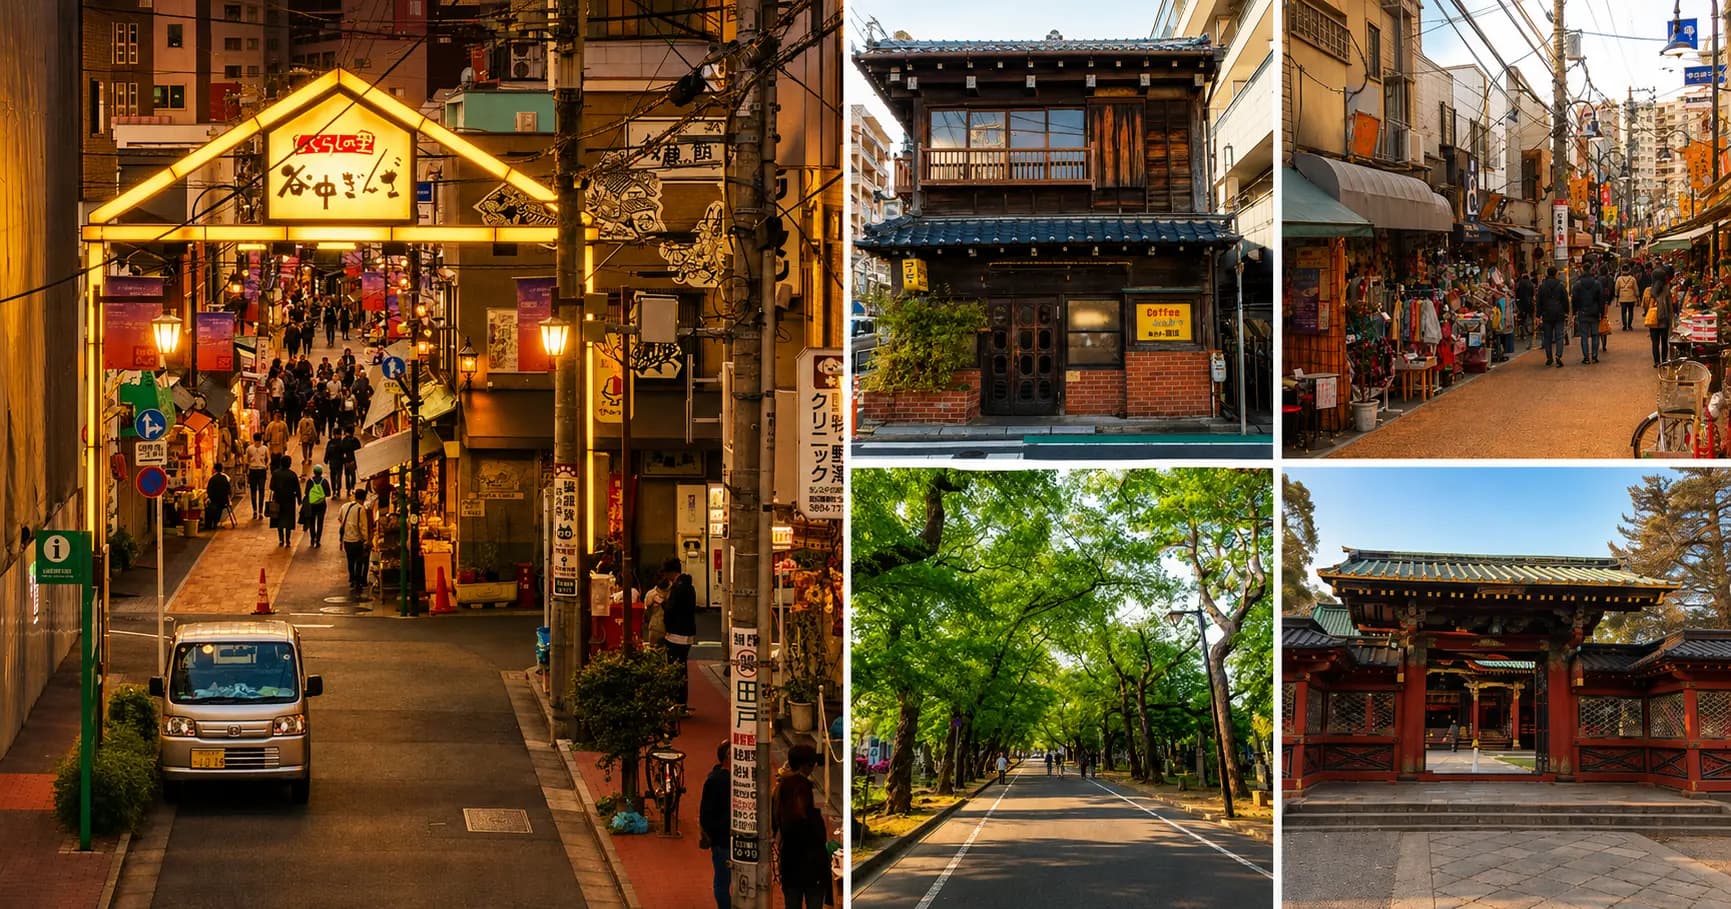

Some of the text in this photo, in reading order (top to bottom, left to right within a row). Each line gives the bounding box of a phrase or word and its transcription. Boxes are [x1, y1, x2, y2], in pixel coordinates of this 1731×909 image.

[277, 149, 402, 210] 谷中ぎんざ
[1146, 308, 1181, 317] Coffee
[810, 392, 828, 483] クリニック
